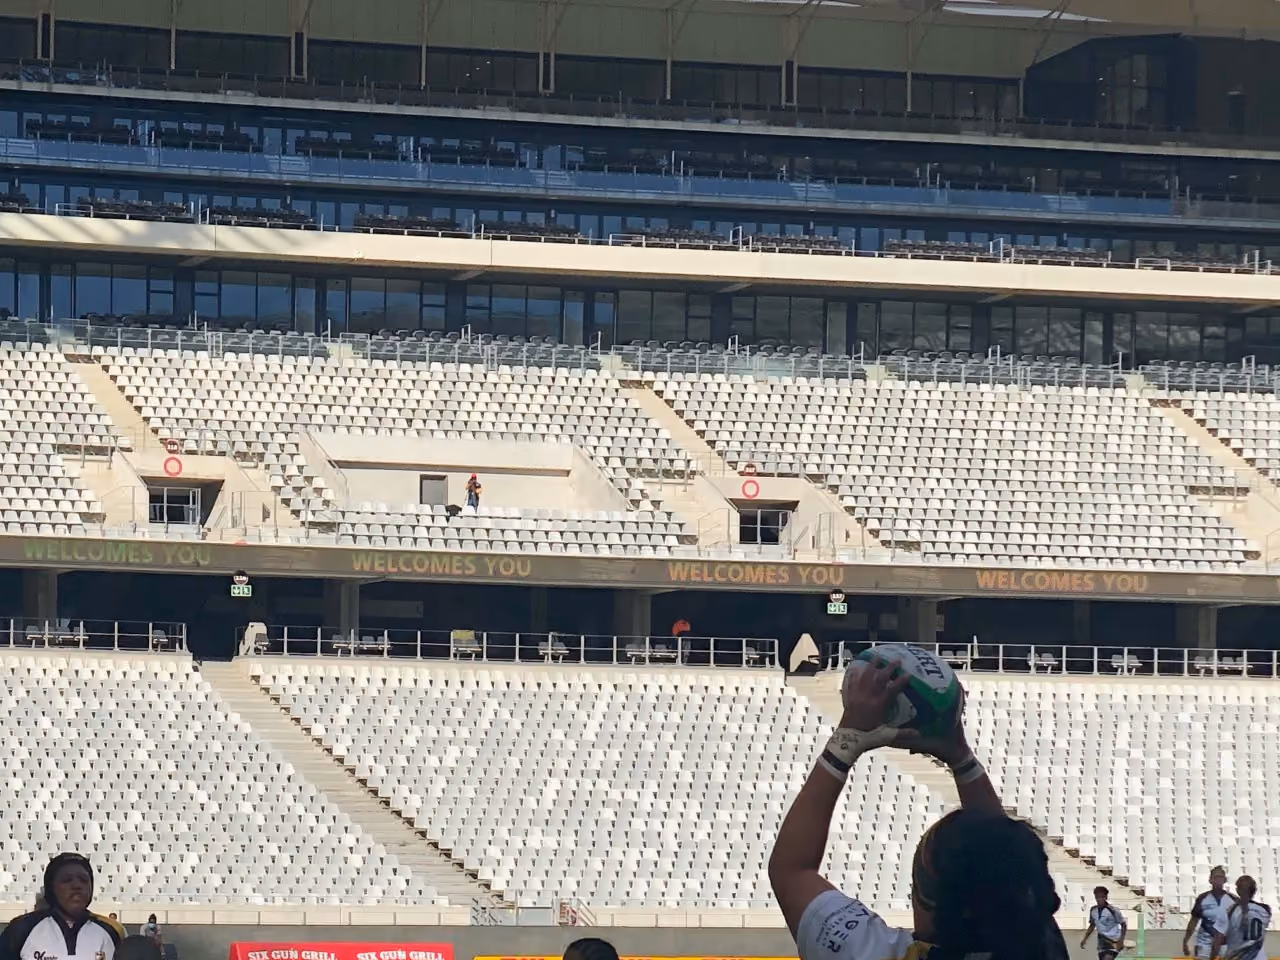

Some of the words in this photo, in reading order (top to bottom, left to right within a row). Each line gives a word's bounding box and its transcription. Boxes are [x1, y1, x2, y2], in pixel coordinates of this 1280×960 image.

[23, 540, 153, 563] WELCOMES
[162, 544, 211, 565] YOU
[351, 551, 477, 576] WELCOMES
[484, 556, 532, 577] YOU
[667, 561, 790, 584] WELCOMES
[797, 566, 845, 586] YOU
[976, 569, 1095, 592] WELCOMES
[1102, 573, 1149, 593] YOU
[271, 948, 299, 960] GUN
[380, 949, 407, 960] GUN
